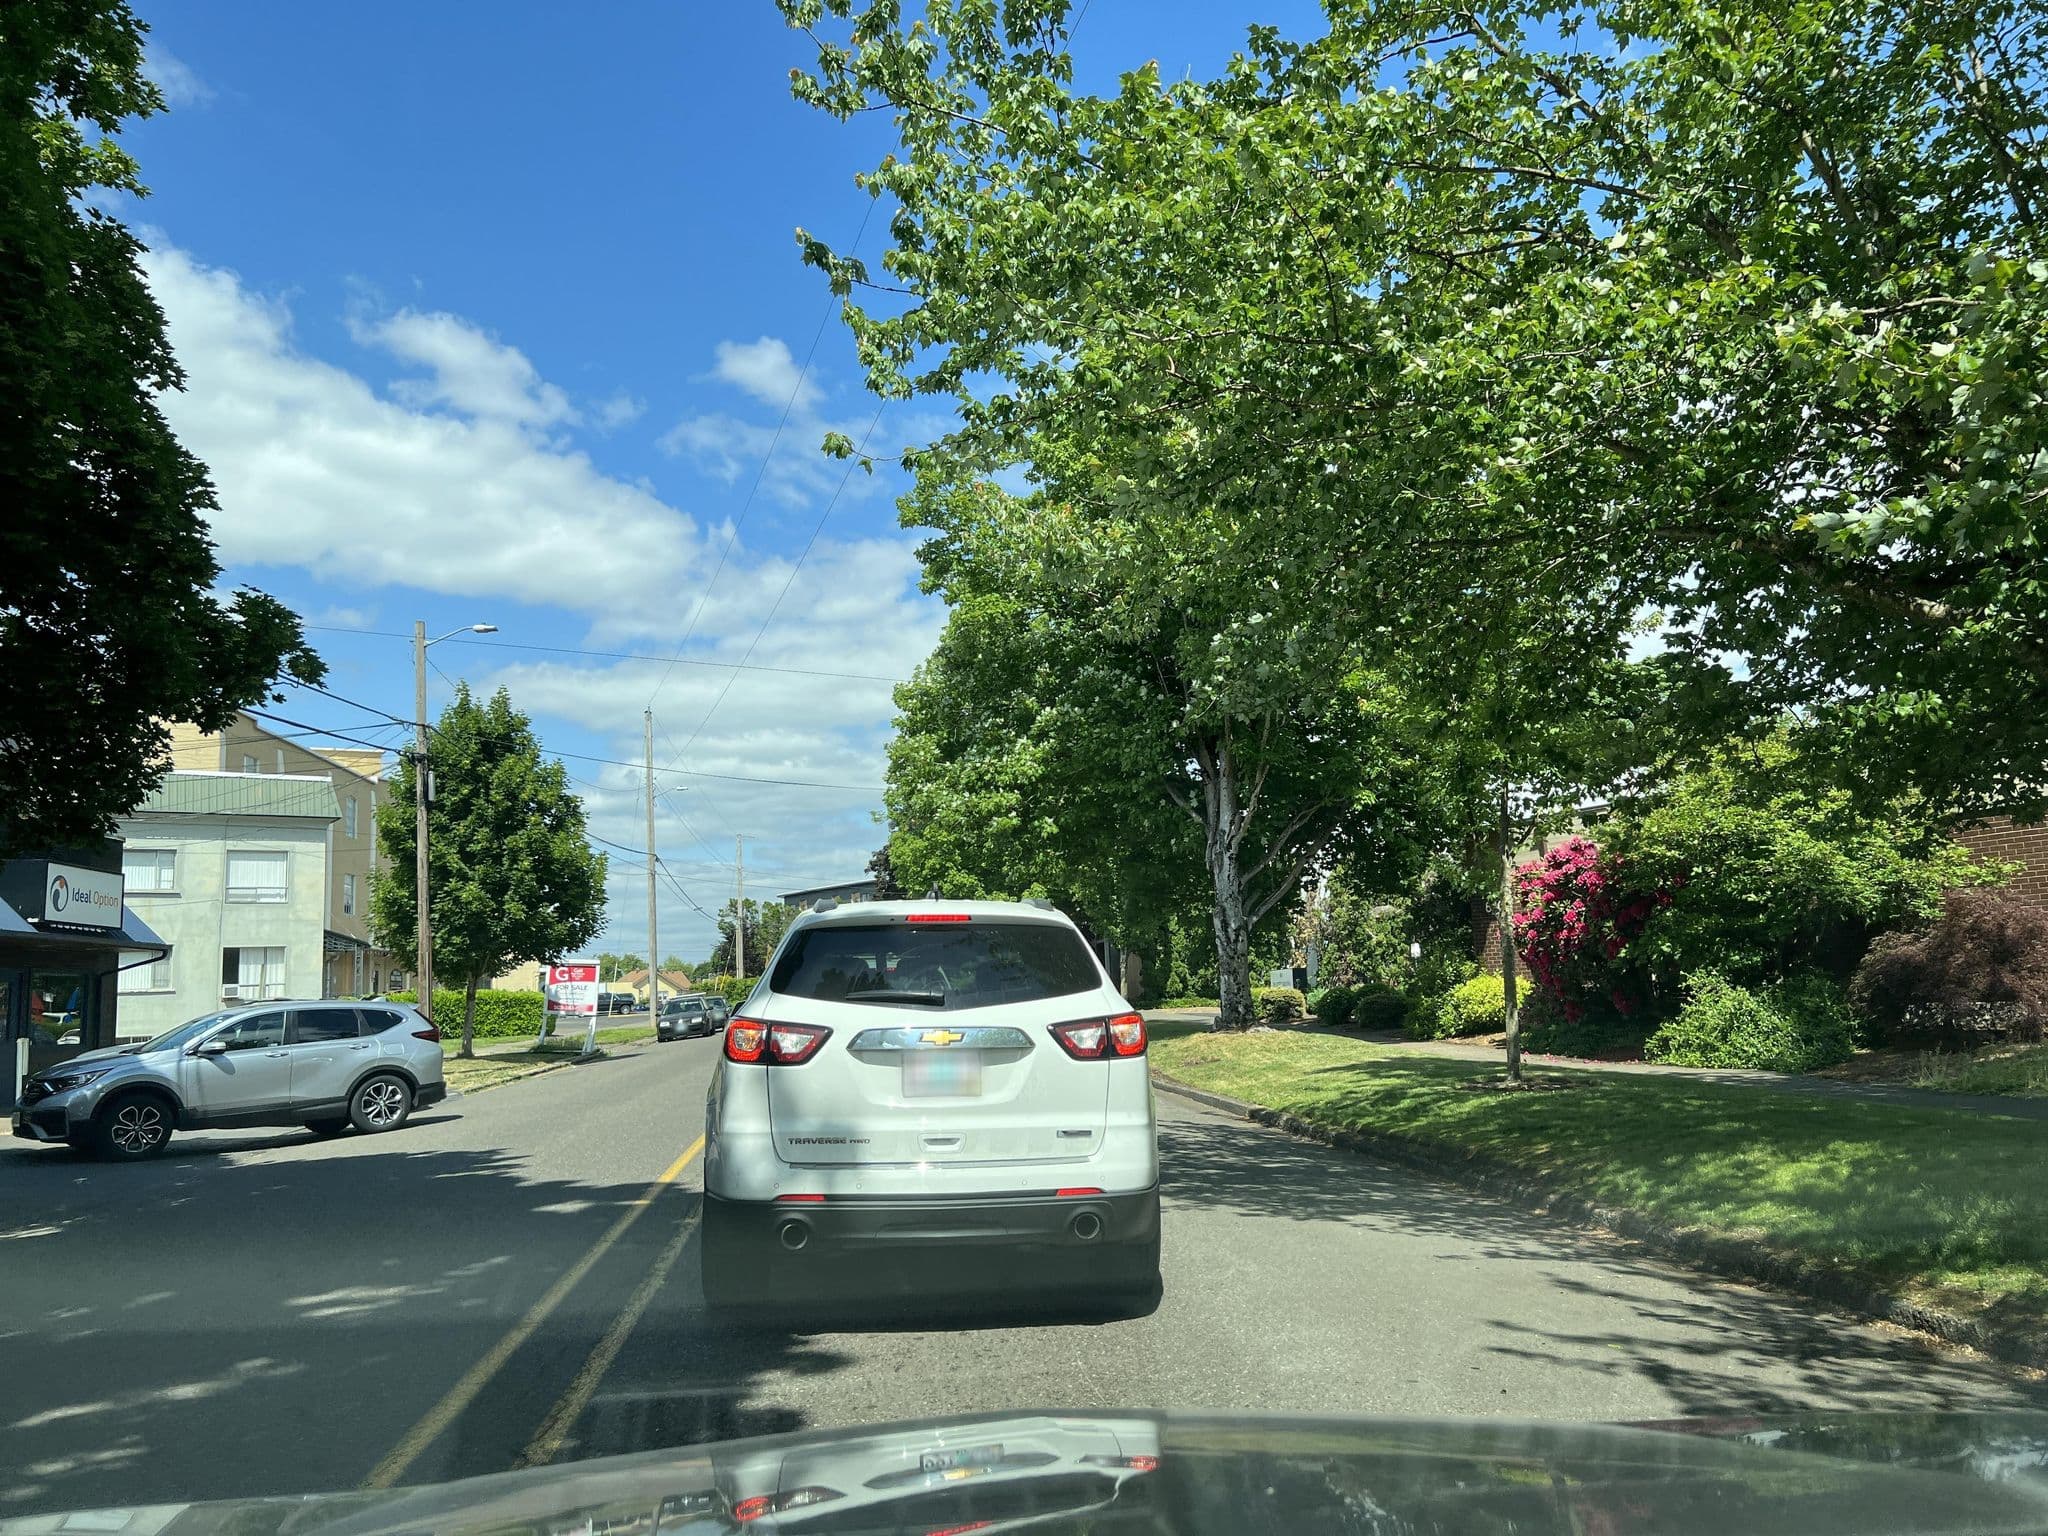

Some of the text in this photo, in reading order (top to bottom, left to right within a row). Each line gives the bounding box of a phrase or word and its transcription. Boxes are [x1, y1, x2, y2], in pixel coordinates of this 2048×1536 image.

[72, 887, 118, 908] Ideal Option
[555, 967, 569, 980] G
